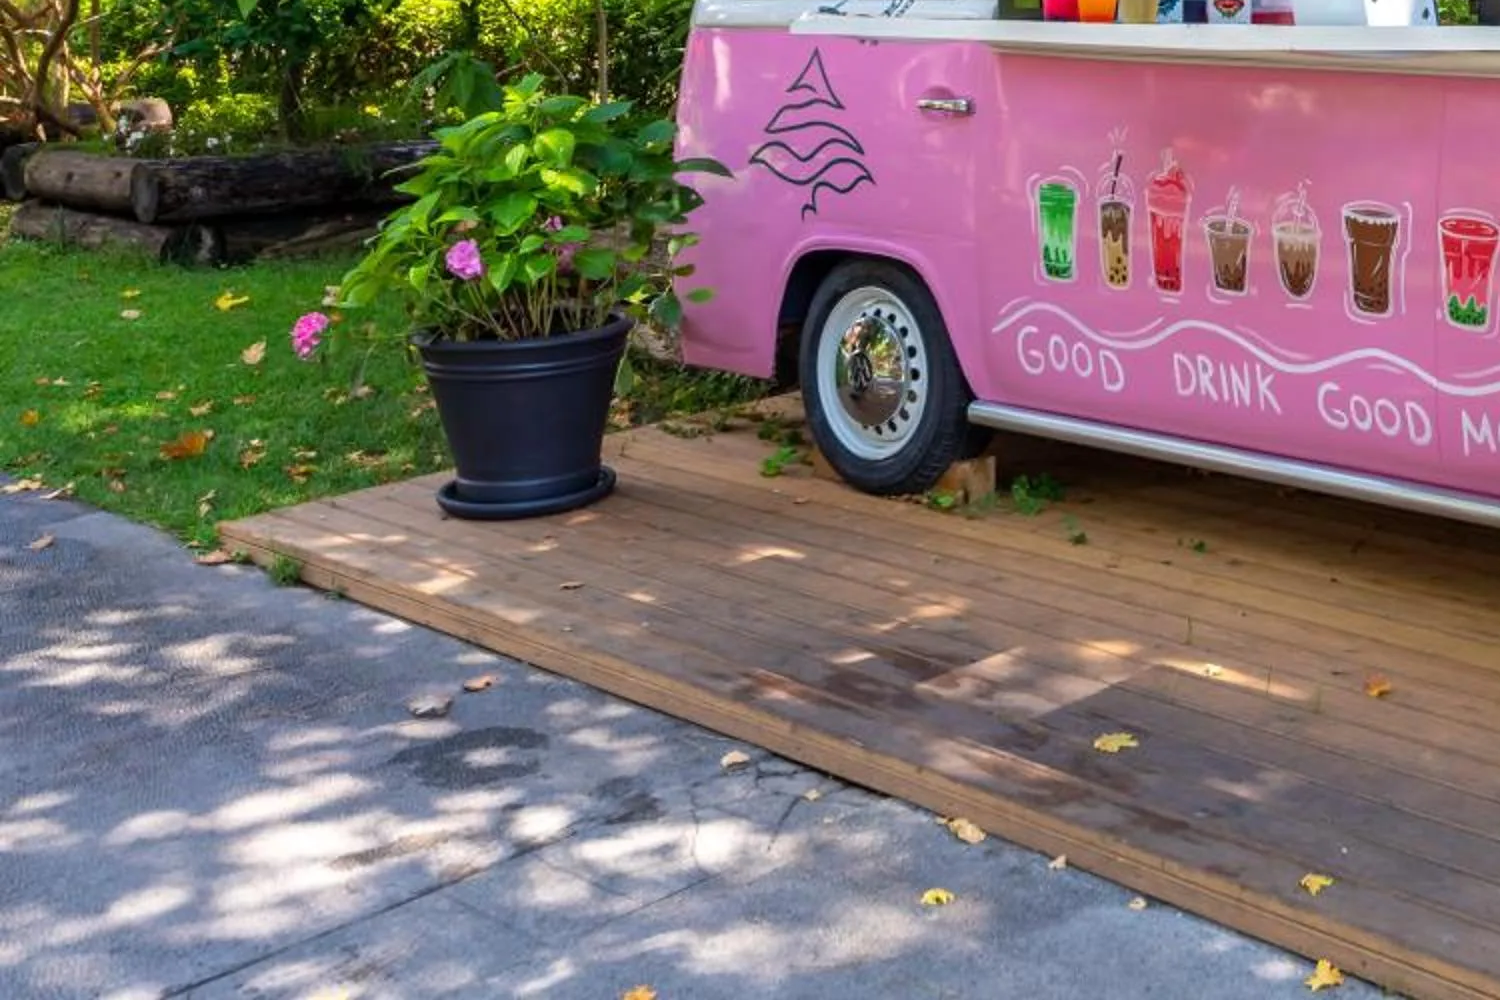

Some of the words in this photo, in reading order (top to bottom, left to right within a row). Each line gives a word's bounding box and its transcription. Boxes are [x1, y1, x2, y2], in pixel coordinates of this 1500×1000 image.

[1018, 325, 1124, 393] GOOD
[1173, 352, 1282, 415] DRINK
[1318, 382, 1433, 447] GOOD
